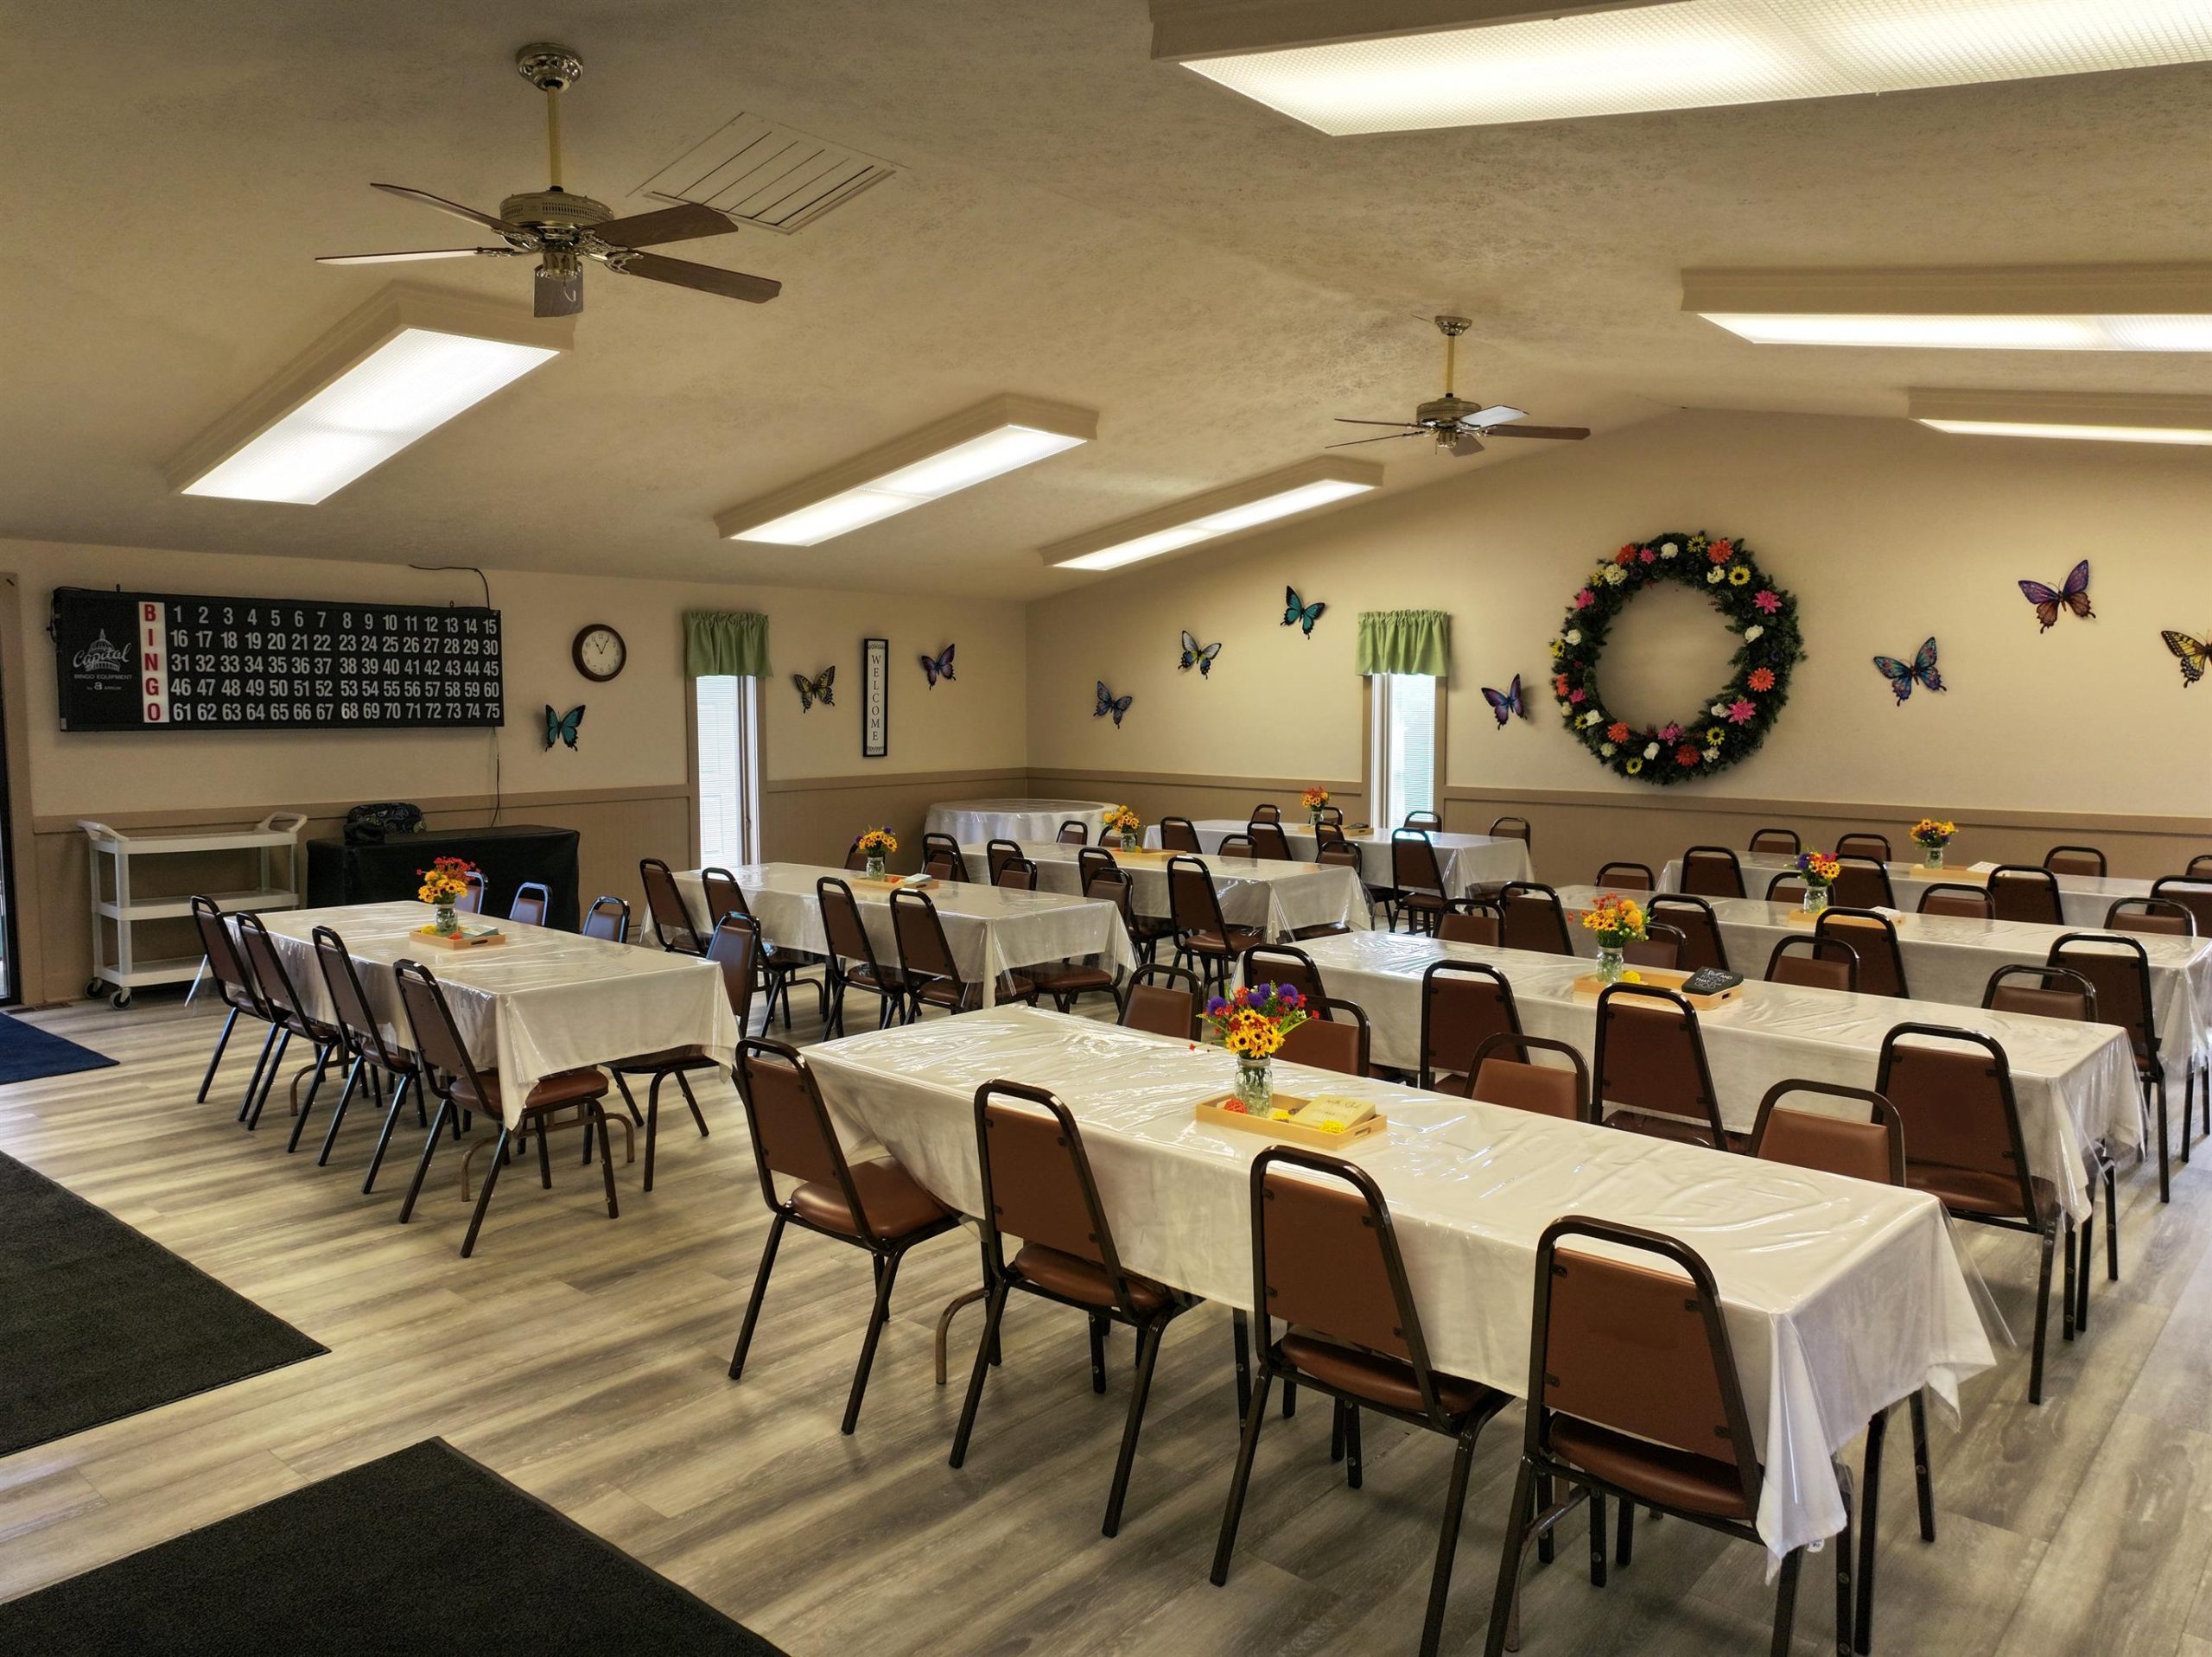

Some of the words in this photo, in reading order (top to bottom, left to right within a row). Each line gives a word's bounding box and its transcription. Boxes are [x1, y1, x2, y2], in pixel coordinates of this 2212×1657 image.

[174, 606, 181, 622] 1
[199, 606, 208, 623] 2
[224, 607, 232, 624] 3
[248, 609, 257, 625] 4
[271, 610, 280, 626] 5
[295, 611, 303, 626] 6
[318, 612, 326, 627] 7
[343, 613, 351, 628] 8
[365, 614, 372, 629] 9
[383, 615, 397, 631] 10
[404, 616, 416, 631] 11
[424, 617, 438, 632] 12
[445, 618, 458, 632] 13
[464, 619, 477, 633] 14
[483, 619, 496, 634] 15
[170, 630, 188, 647] 16
[196, 631, 213, 647] 17
[220, 632, 237, 648] 18
[245, 632, 261, 649] 19
[268, 633, 285, 650] 20
[292, 634, 307, 650] 21
[314, 635, 331, 651] 22
[340, 635, 356, 651] 23
[361, 636, 378, 651] 24
[383, 637, 398, 652] 25
[404, 637, 419, 652] 26
[423, 638, 439, 653] 27
[444, 638, 460, 654] 28
[463, 639, 479, 654] 29
[483, 640, 498, 655] 30
[73, 643, 131, 668] Capital
[143, 604, 162, 722] BINGO
[172, 654, 188, 671] 31
[196, 655, 215, 671] 32
[220, 656, 239, 672] 33
[245, 656, 264, 672] 34
[269, 657, 287, 673] 35
[292, 657, 309, 674] 36
[315, 657, 332, 674] 37
[340, 657, 357, 674] 38
[362, 658, 378, 674] 39
[383, 659, 399, 675] 40
[404, 659, 419, 675] 41
[424, 660, 440, 675] 42
[445, 660, 461, 676] 43
[464, 661, 480, 676] 44
[483, 661, 499, 676] 45
[171, 678, 191, 695] 46
[197, 679, 215, 695] 47
[221, 679, 240, 696] 48
[245, 679, 264, 695] 49
[270, 680, 288, 696] 50
[295, 680, 309, 696] 51
[316, 681, 333, 696] 52
[341, 680, 358, 696] 53
[363, 681, 378, 696] 54
[384, 681, 400, 696] 55
[404, 682, 420, 696] 56
[425, 682, 440, 696] 57
[445, 682, 461, 697] 58
[465, 682, 480, 697] 59
[484, 682, 499, 697] 60
[871, 655, 881, 740] WELCOME
[174, 703, 191, 721] 61
[198, 703, 217, 721] 62
[223, 703, 241, 721] 63
[246, 703, 264, 720] 64
[270, 704, 289, 720] 65
[294, 703, 311, 720] 66
[316, 704, 334, 720] 67
[341, 702, 359, 719] 68
[363, 702, 379, 719] 69
[385, 702, 400, 719] 70
[406, 703, 420, 718] 71
[426, 703, 441, 718] 72
[446, 703, 461, 718] 73
[466, 703, 480, 718] 74
[485, 703, 499, 718] 75
